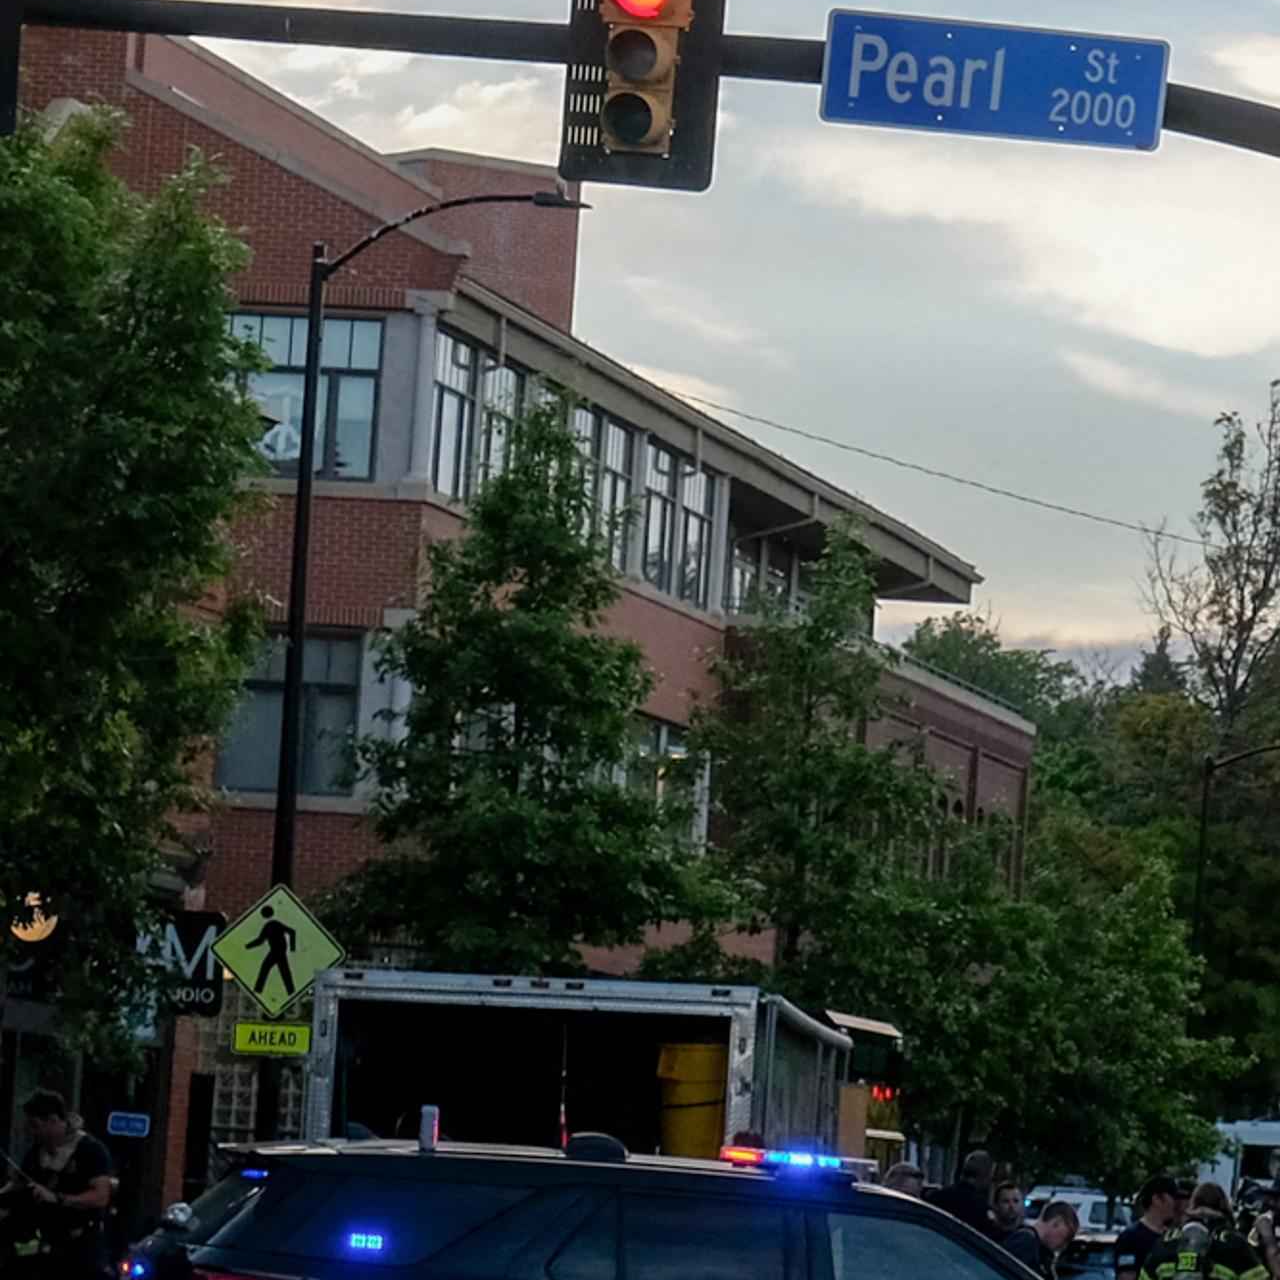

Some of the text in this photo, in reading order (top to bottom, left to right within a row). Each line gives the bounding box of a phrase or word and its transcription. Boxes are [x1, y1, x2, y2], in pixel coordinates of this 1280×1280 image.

[847, 33, 1006, 111] Pearl
[1084, 48, 1120, 85] St
[1048, 88, 1136, 129] 2000
[248, 1031, 297, 1047] AHEAD
